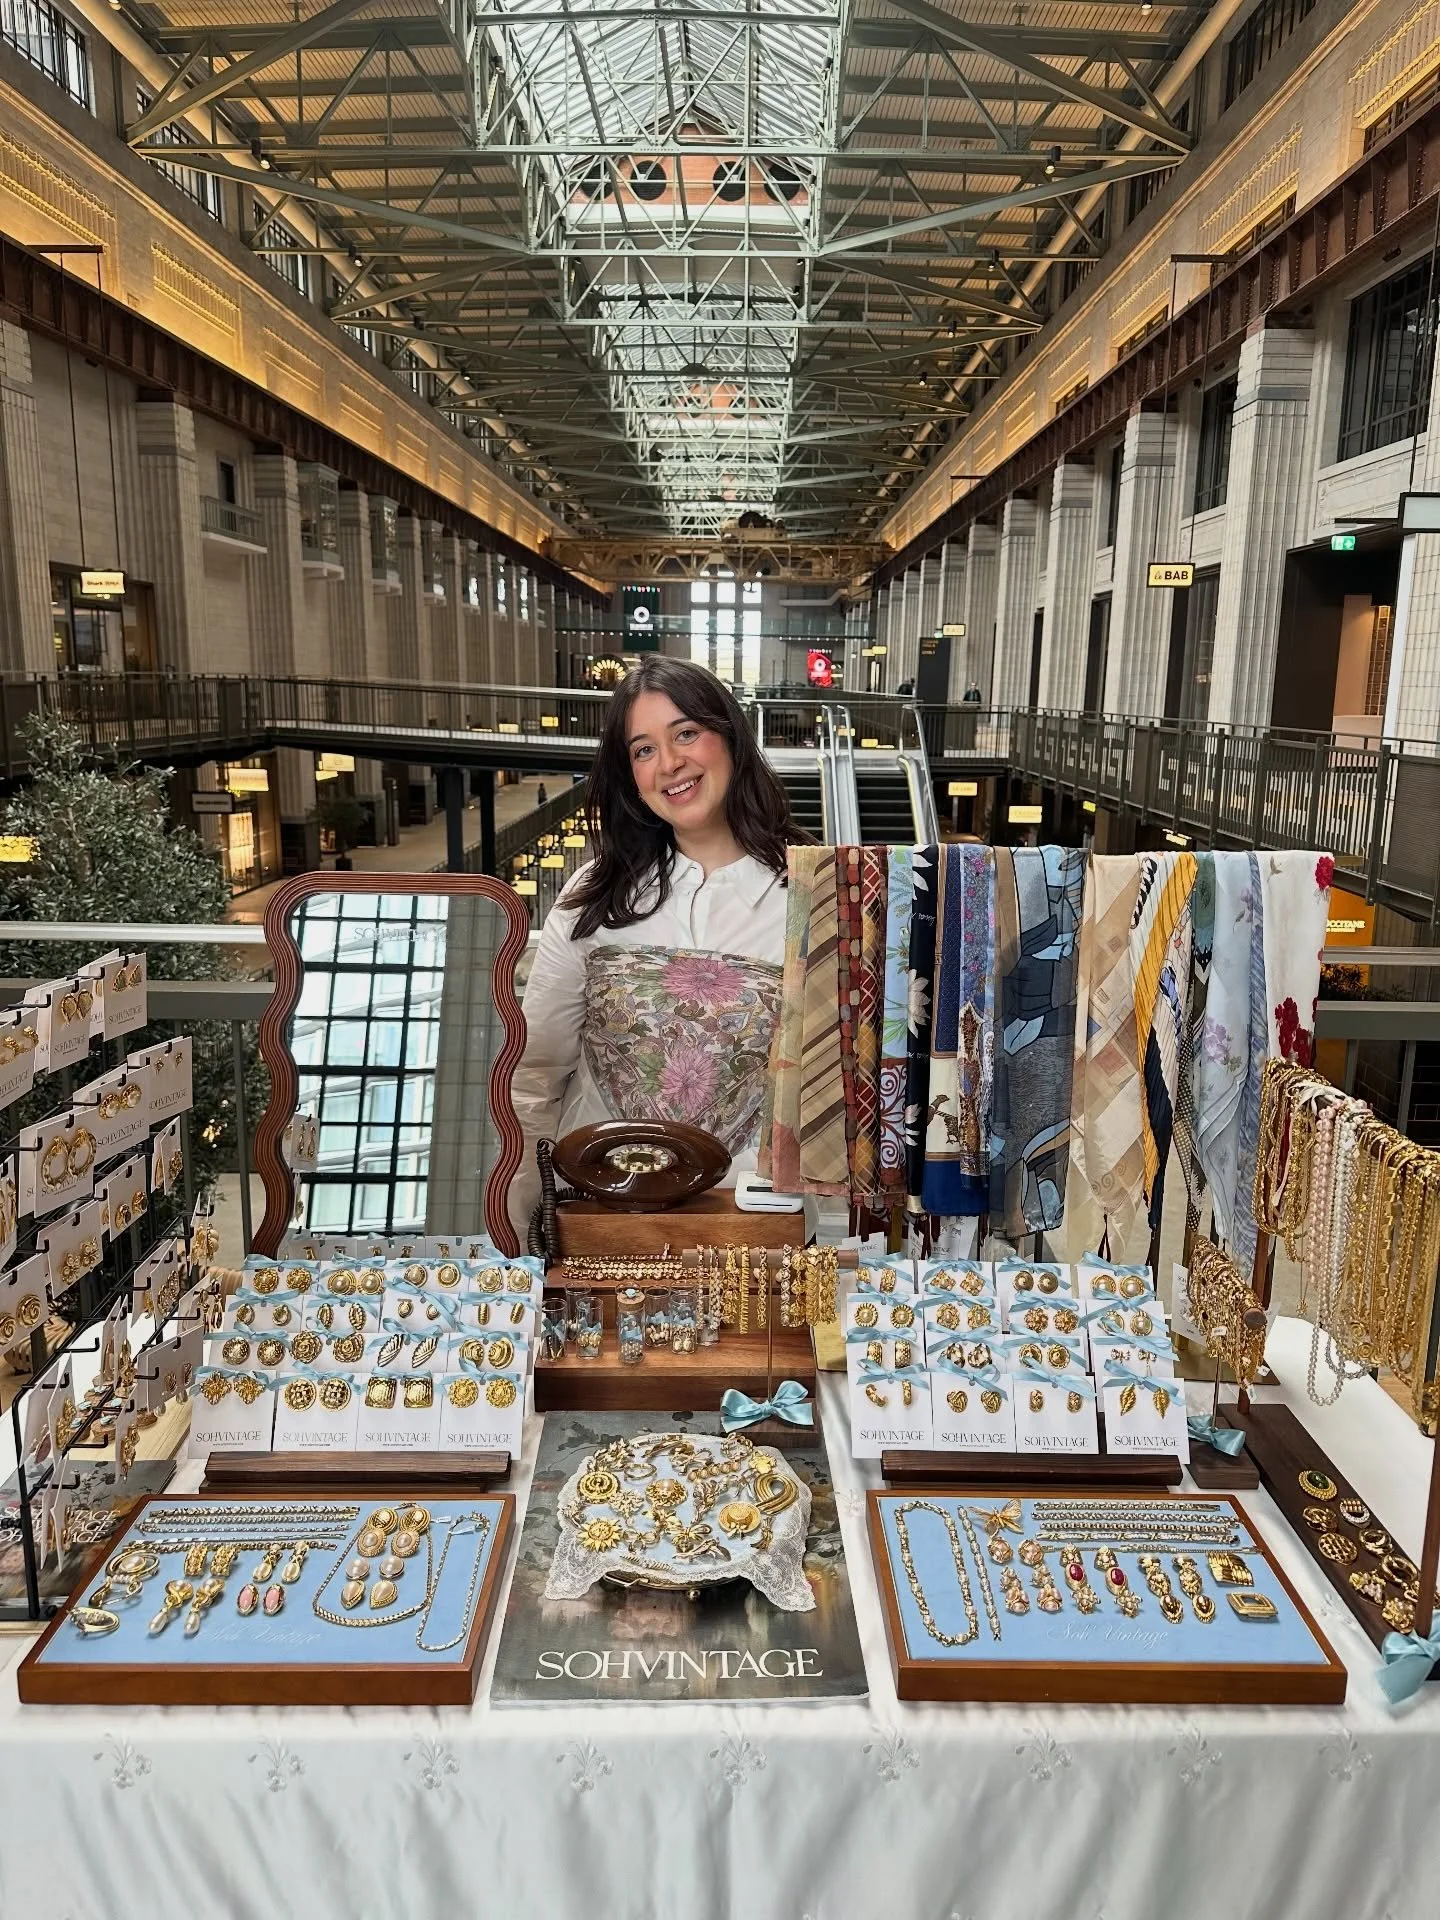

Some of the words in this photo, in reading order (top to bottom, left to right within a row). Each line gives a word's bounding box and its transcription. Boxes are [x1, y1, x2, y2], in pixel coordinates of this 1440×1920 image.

[1164, 570, 1189, 580] BAB
[97, 1118, 145, 1147] SOHVINTAGE
[195, 1430, 262, 1443] SOHVINTAGE
[282, 1431, 349, 1443] SOHVINTAGE
[365, 1431, 431, 1443] SOHVINTAGE
[447, 1432, 513, 1444] SOHVINTAGE
[860, 1430, 925, 1441] SOHVINTAGE
[941, 1432, 1006, 1444] SOHVINTAGE
[1024, 1435, 1089, 1447] SOHVINTAGE
[1114, 1435, 1181, 1447] SOHVINTAGE
[1104, 1621, 1169, 1650] Vintage
[535, 1648, 824, 1680] SOHVINTAGE
